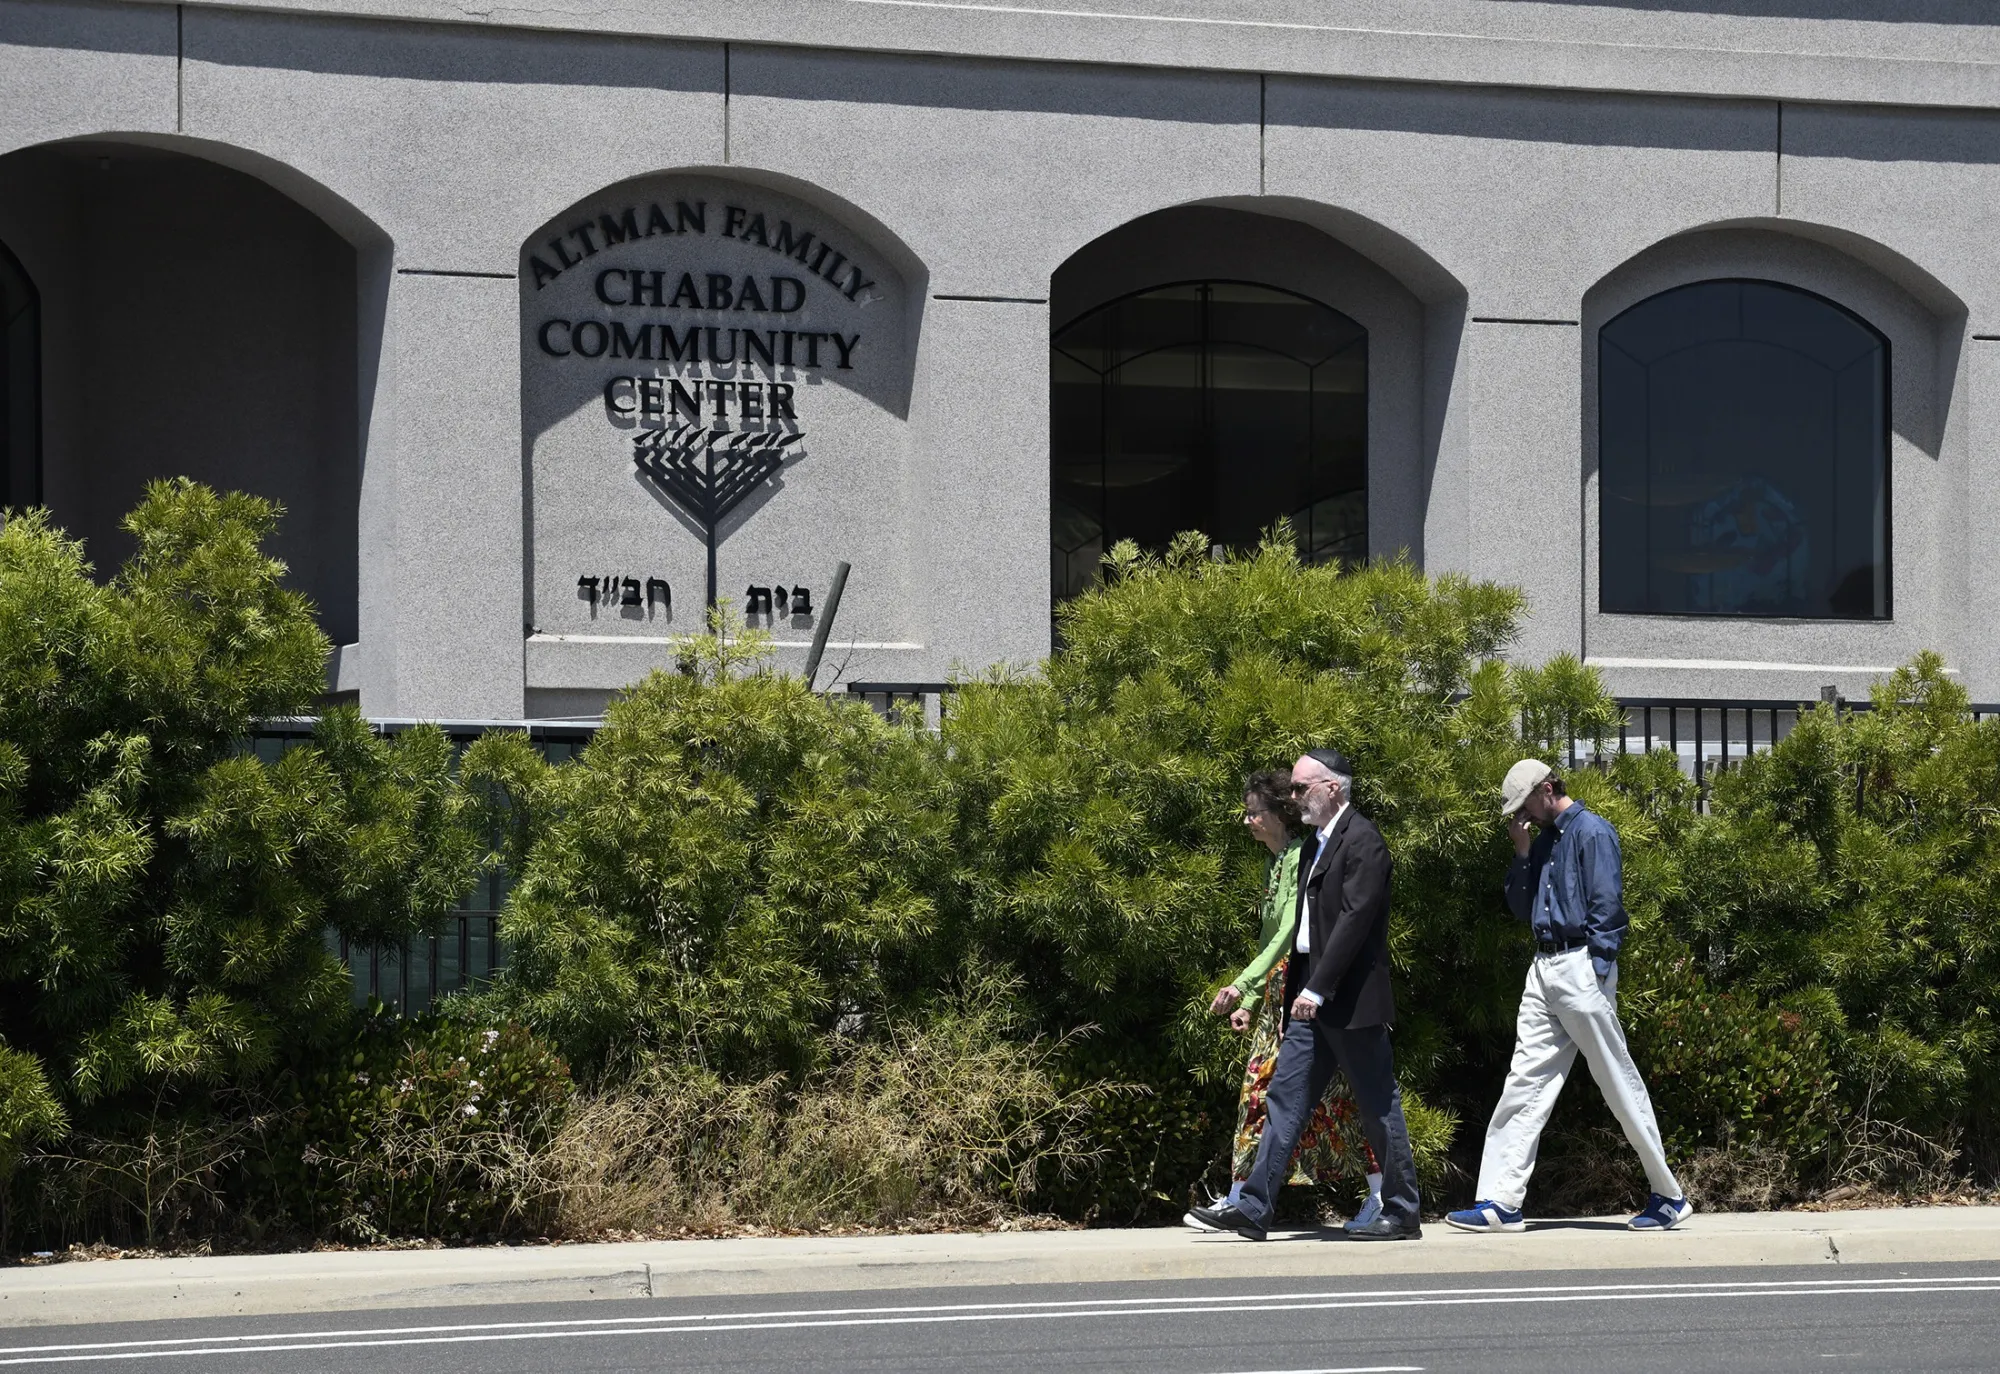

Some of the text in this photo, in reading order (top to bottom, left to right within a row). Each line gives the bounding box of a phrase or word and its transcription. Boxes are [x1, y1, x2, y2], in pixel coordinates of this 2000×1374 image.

[529, 200, 875, 302] ALTMAN FAMILY
[594, 268, 806, 313] CHABAD
[538, 319, 860, 370] COMMUNITY
[604, 376, 798, 420] CENTER
[746, 584, 813, 615] בית
